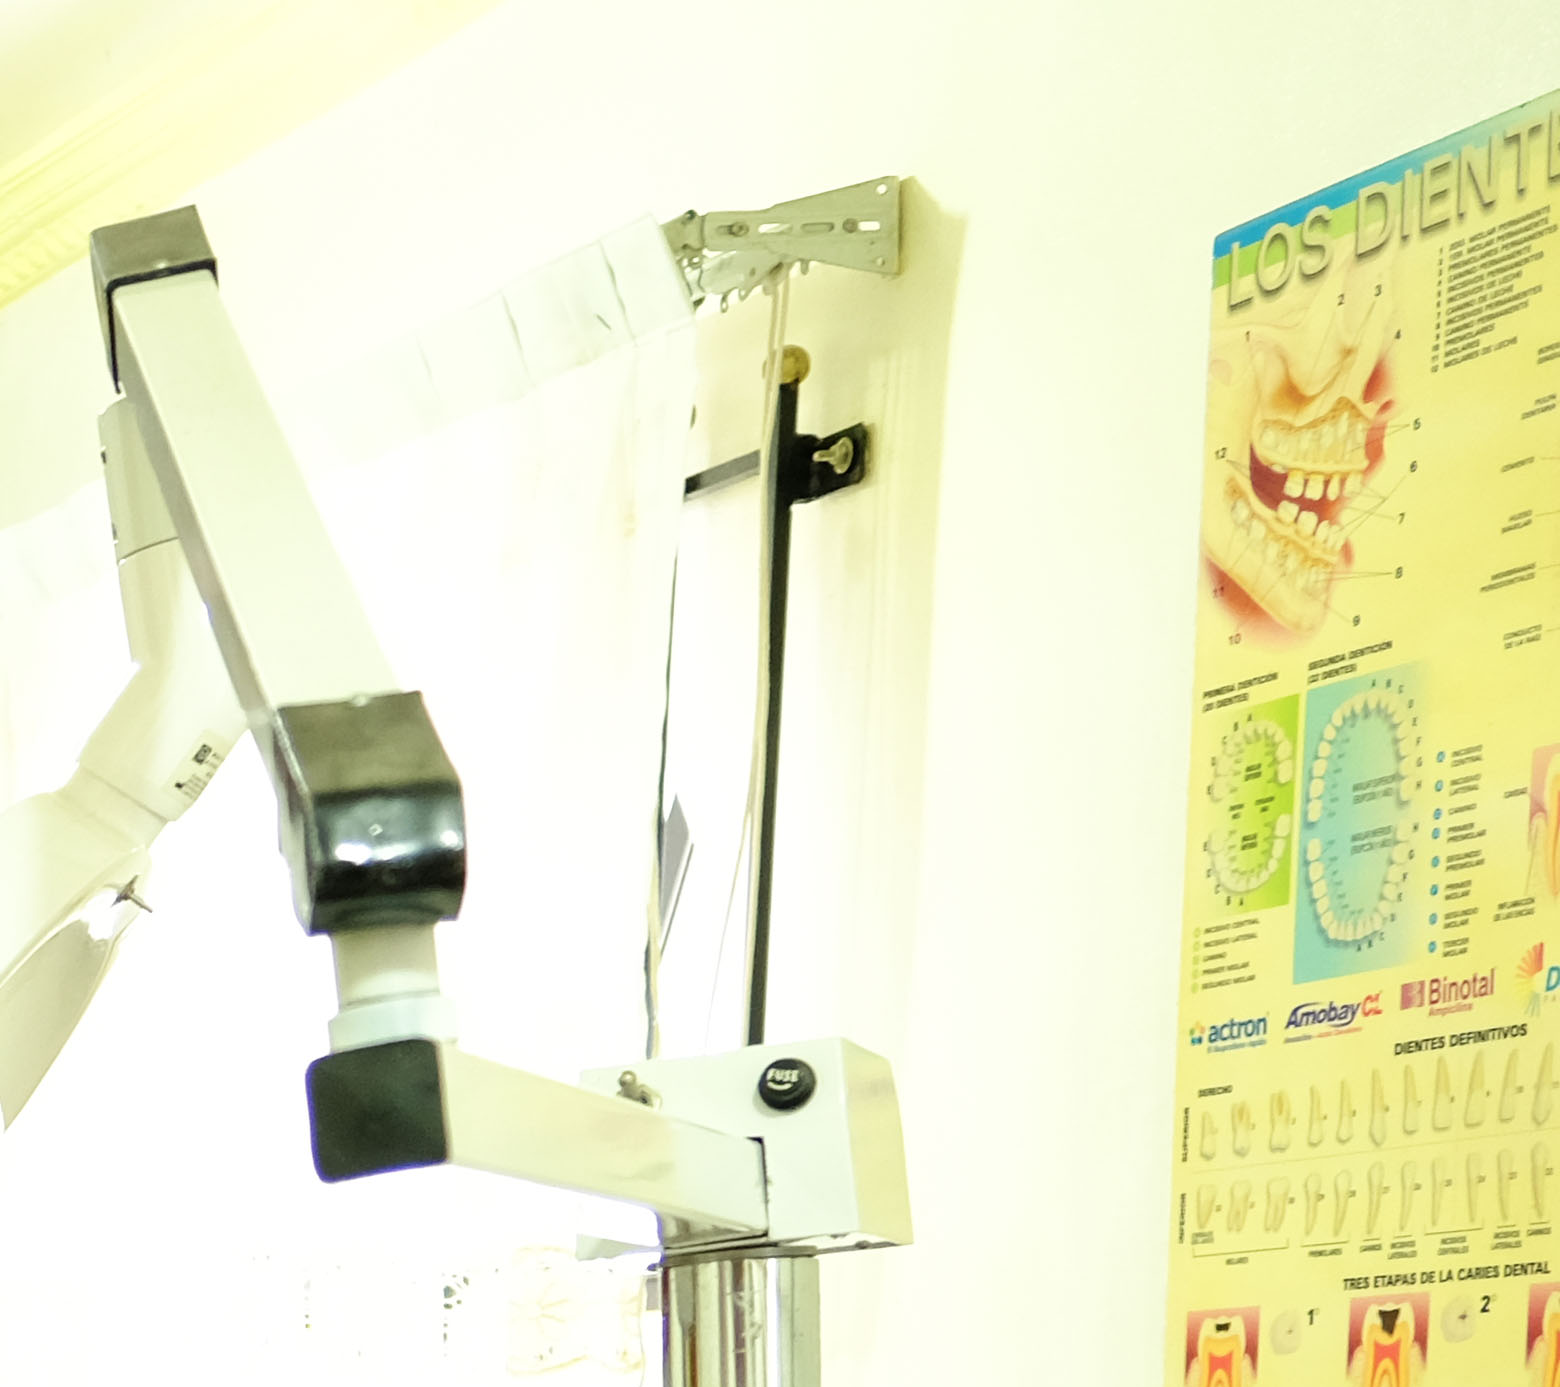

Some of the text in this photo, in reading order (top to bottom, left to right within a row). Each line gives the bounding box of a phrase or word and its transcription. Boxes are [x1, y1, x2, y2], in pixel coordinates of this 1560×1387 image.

[1228, 204, 1333, 312] LOS
[1374, 284, 1382, 297] 3
[1337, 294, 1345, 306] 2
[1413, 418, 1421, 430] 5
[1214, 447, 1227, 460] 12
[1409, 460, 1418, 472] 6
[1398, 512, 1406, 524] 7
[1395, 566, 1403, 579] 8
[1352, 615, 1361, 628] 9
[1228, 632, 1242, 645] 10
[1429, 967, 1495, 1006] Binotal
[1285, 1001, 1361, 1029] Amobay
[1208, 1016, 1268, 1044] actron
[1395, 1024, 1528, 1056] DIENTES DEFINITIVOS
[1343, 1261, 1551, 1291] TRES ETAPAS DE LA CARIES DENTAL
